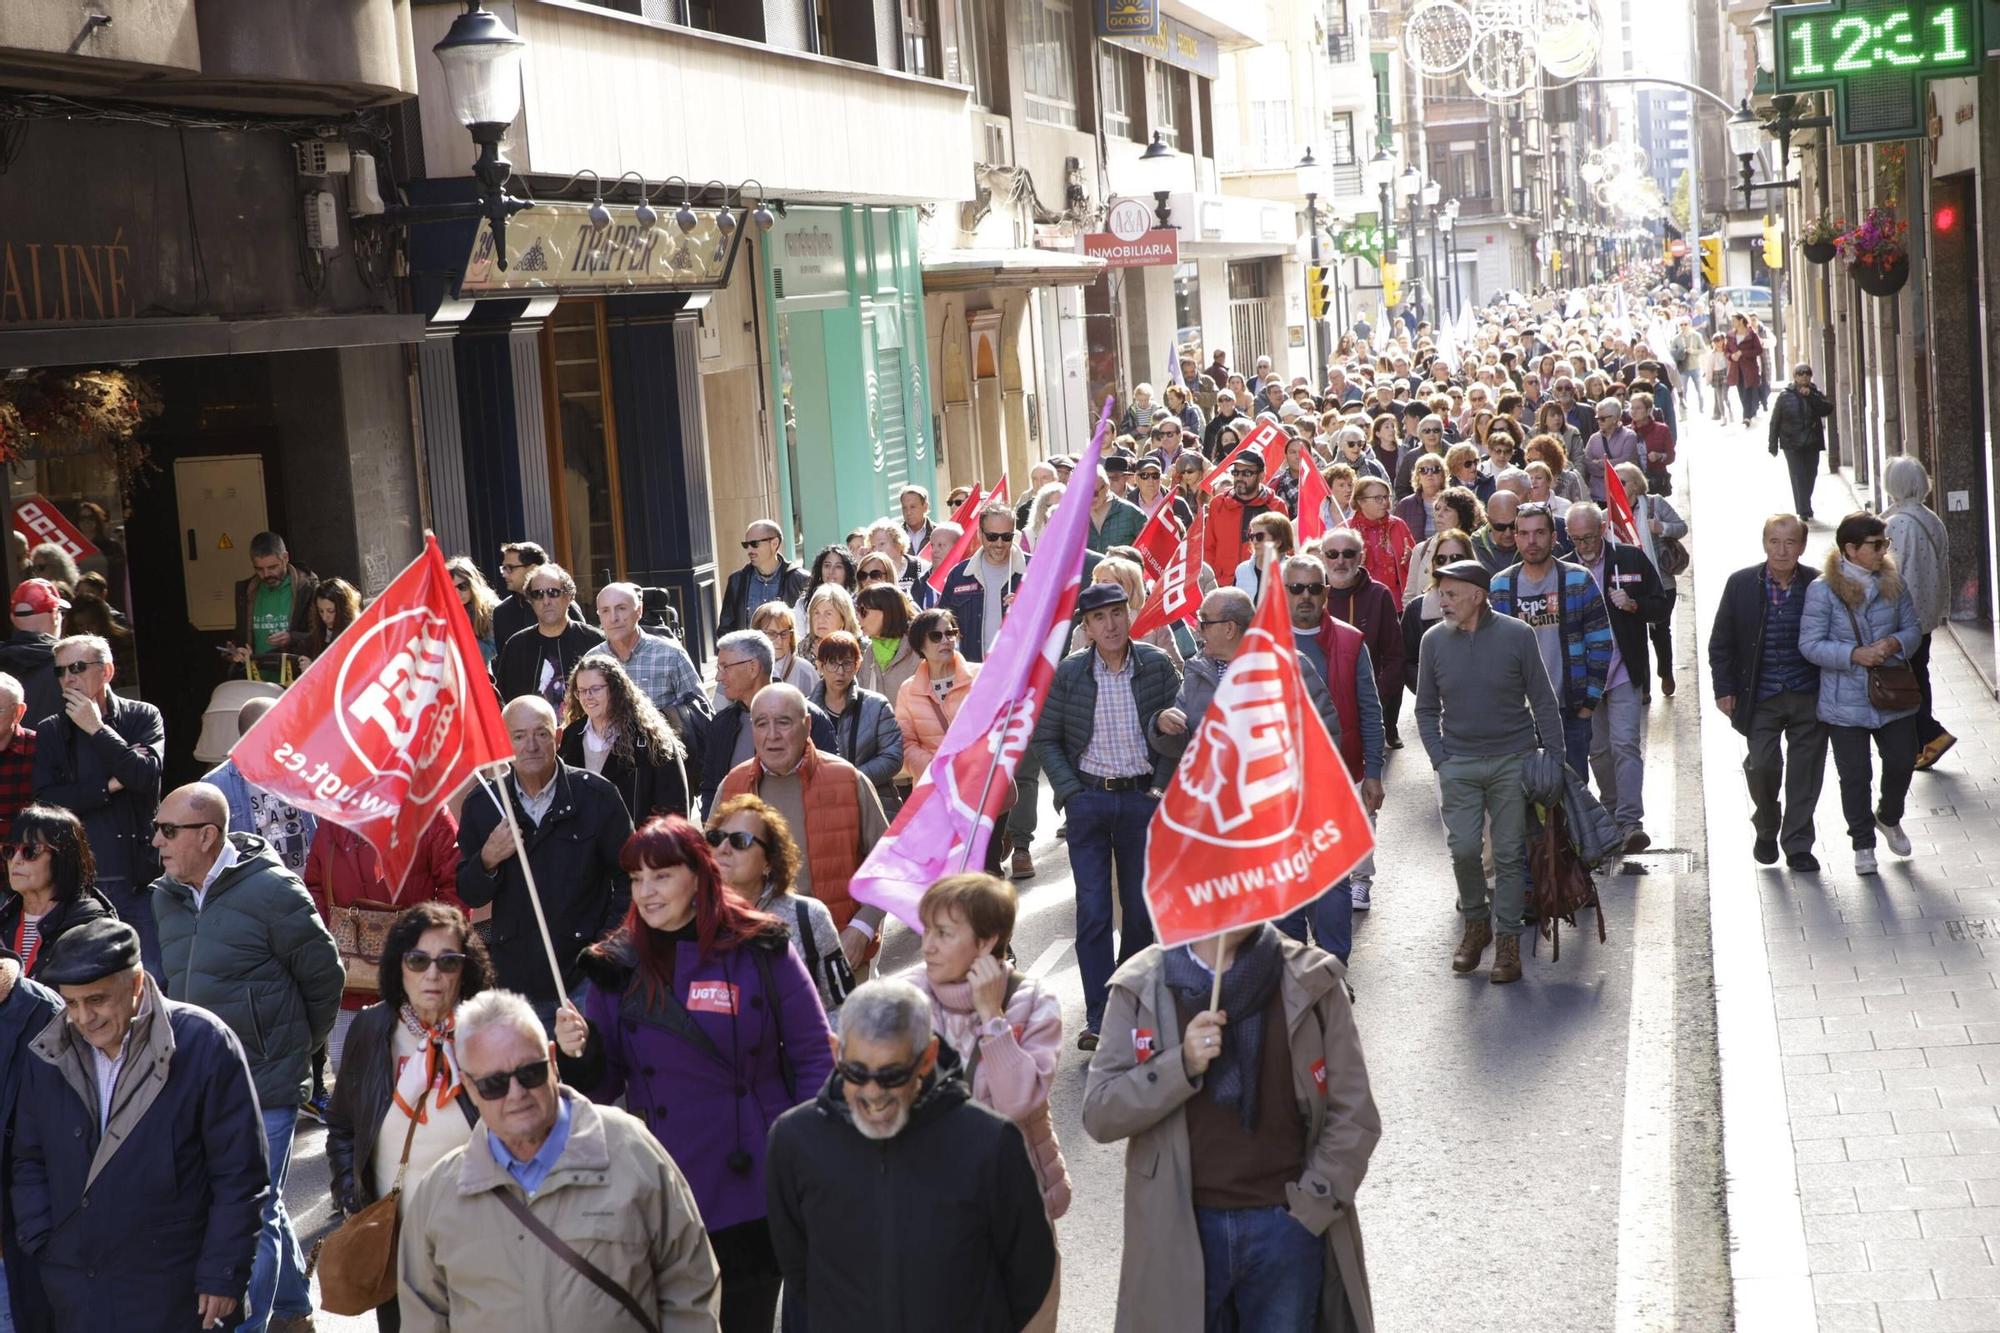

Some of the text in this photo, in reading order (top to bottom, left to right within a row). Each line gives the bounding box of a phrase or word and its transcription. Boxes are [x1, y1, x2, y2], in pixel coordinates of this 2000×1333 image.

[1110, 15, 1150, 26] OCASO
[1791, 7, 1967, 76] 12:31
[1115, 208, 1145, 233] A&A
[1088, 243, 1173, 259] INMOBILIARIA
[1139, 543, 1164, 576] ASTURIA
[1185, 819, 1342, 907] www.ugt.es
[691, 987, 717, 1000] UGT
